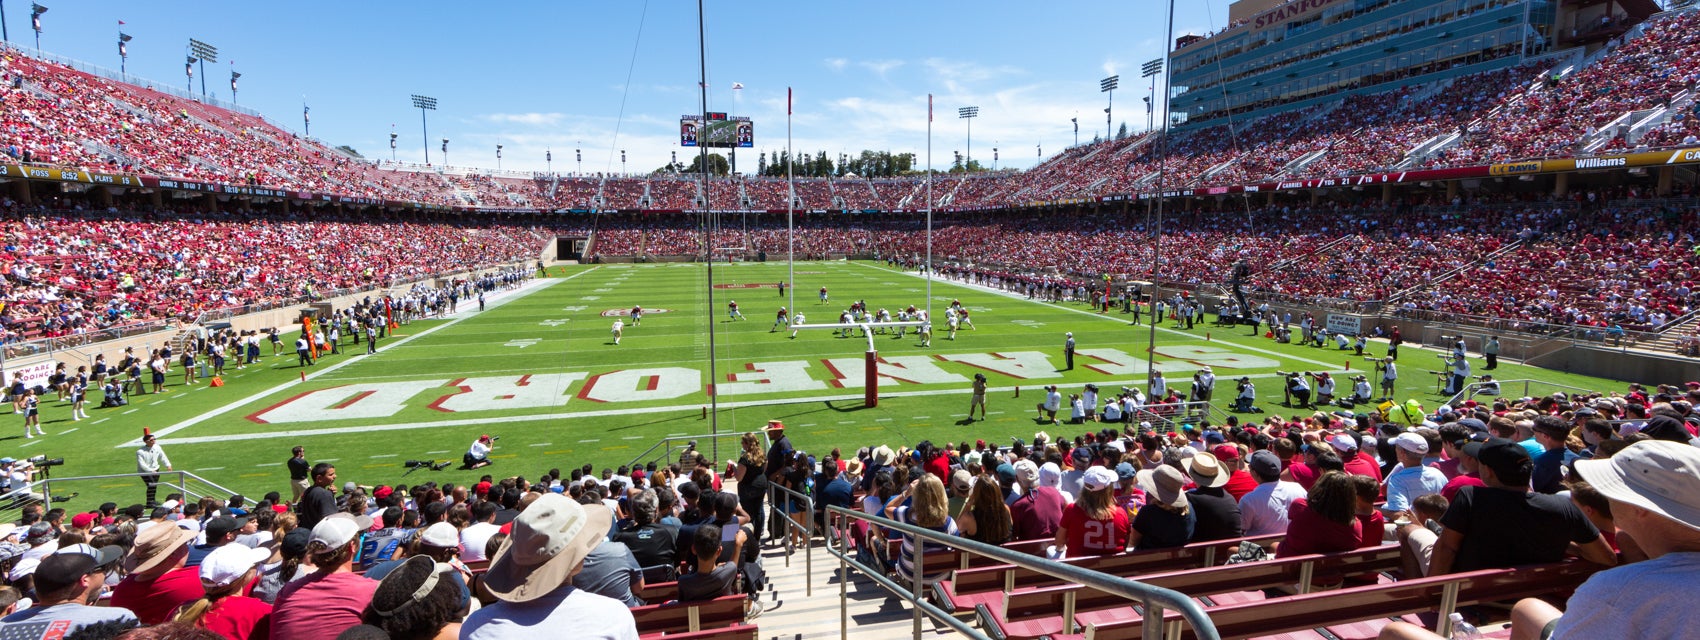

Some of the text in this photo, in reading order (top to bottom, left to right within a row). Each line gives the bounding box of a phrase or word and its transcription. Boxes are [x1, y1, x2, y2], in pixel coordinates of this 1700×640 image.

[1255, 0, 1333, 29] STANFO
[1508, 163, 1538, 173] DAVIS
[1575, 157, 1626, 169] Williams
[30, 169, 78, 181] POSS 8:52
[94, 174, 113, 183] PLAYS
[35, 364, 50, 372] ARE
[1084, 520, 1117, 549] 21
